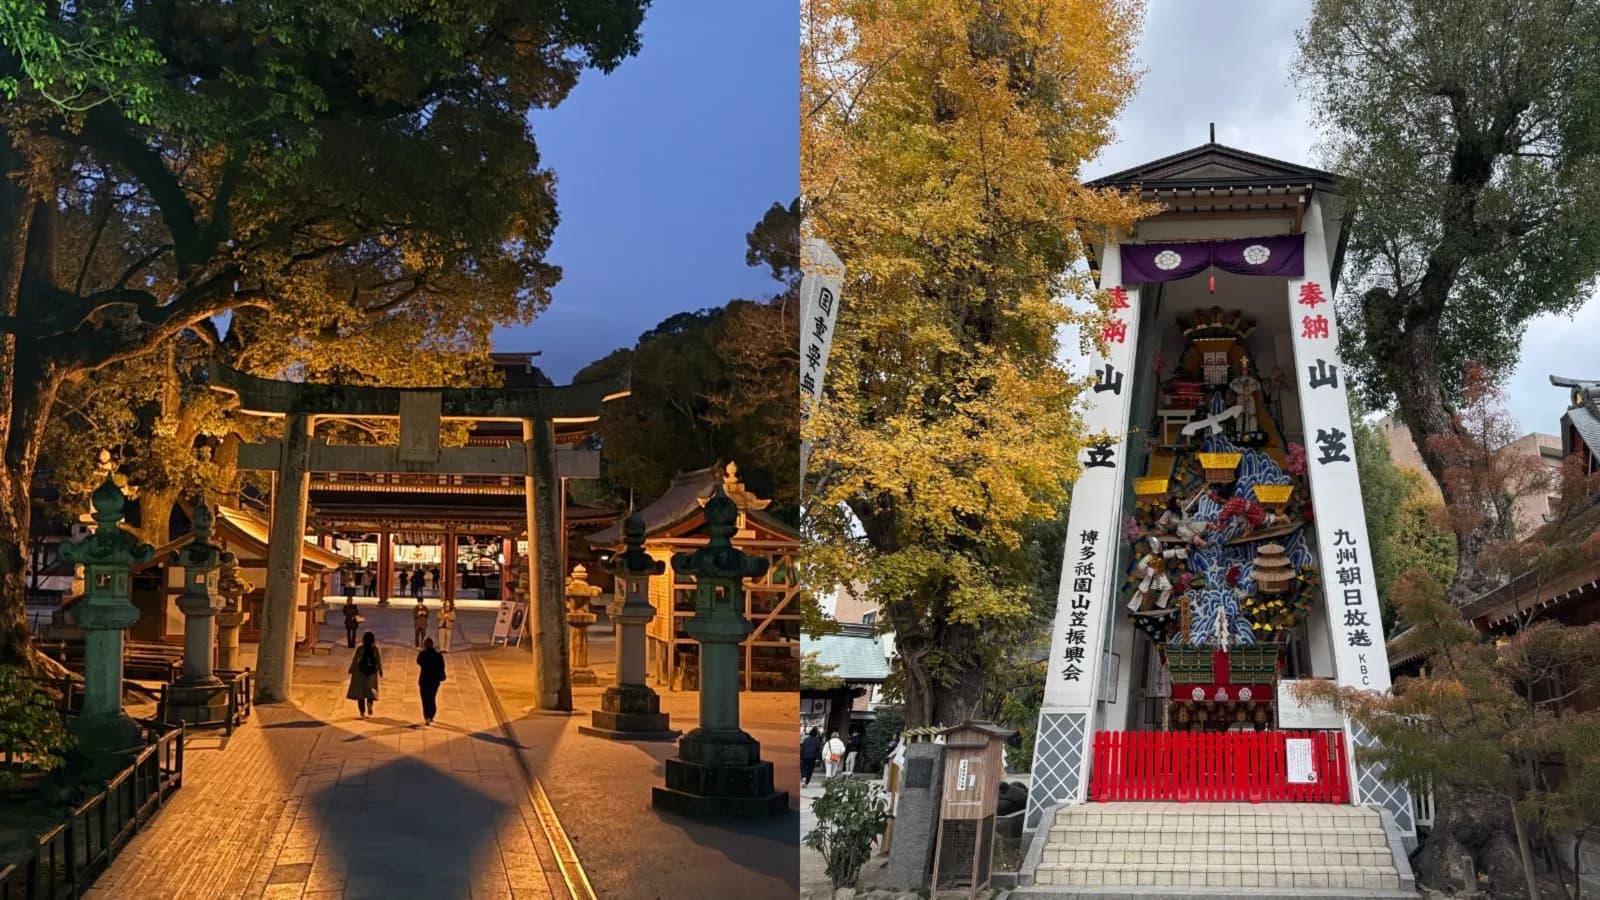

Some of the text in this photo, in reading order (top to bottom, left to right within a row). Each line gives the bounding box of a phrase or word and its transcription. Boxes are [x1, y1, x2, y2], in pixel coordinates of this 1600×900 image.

[800, 287, 834, 419] 国重要無
[1298, 281, 1373, 647] 奉納 山笠 九州朝日放送
[1061, 529, 1099, 682] 博多祇園山笠振興会
[1359, 654, 1370, 685] KBC
